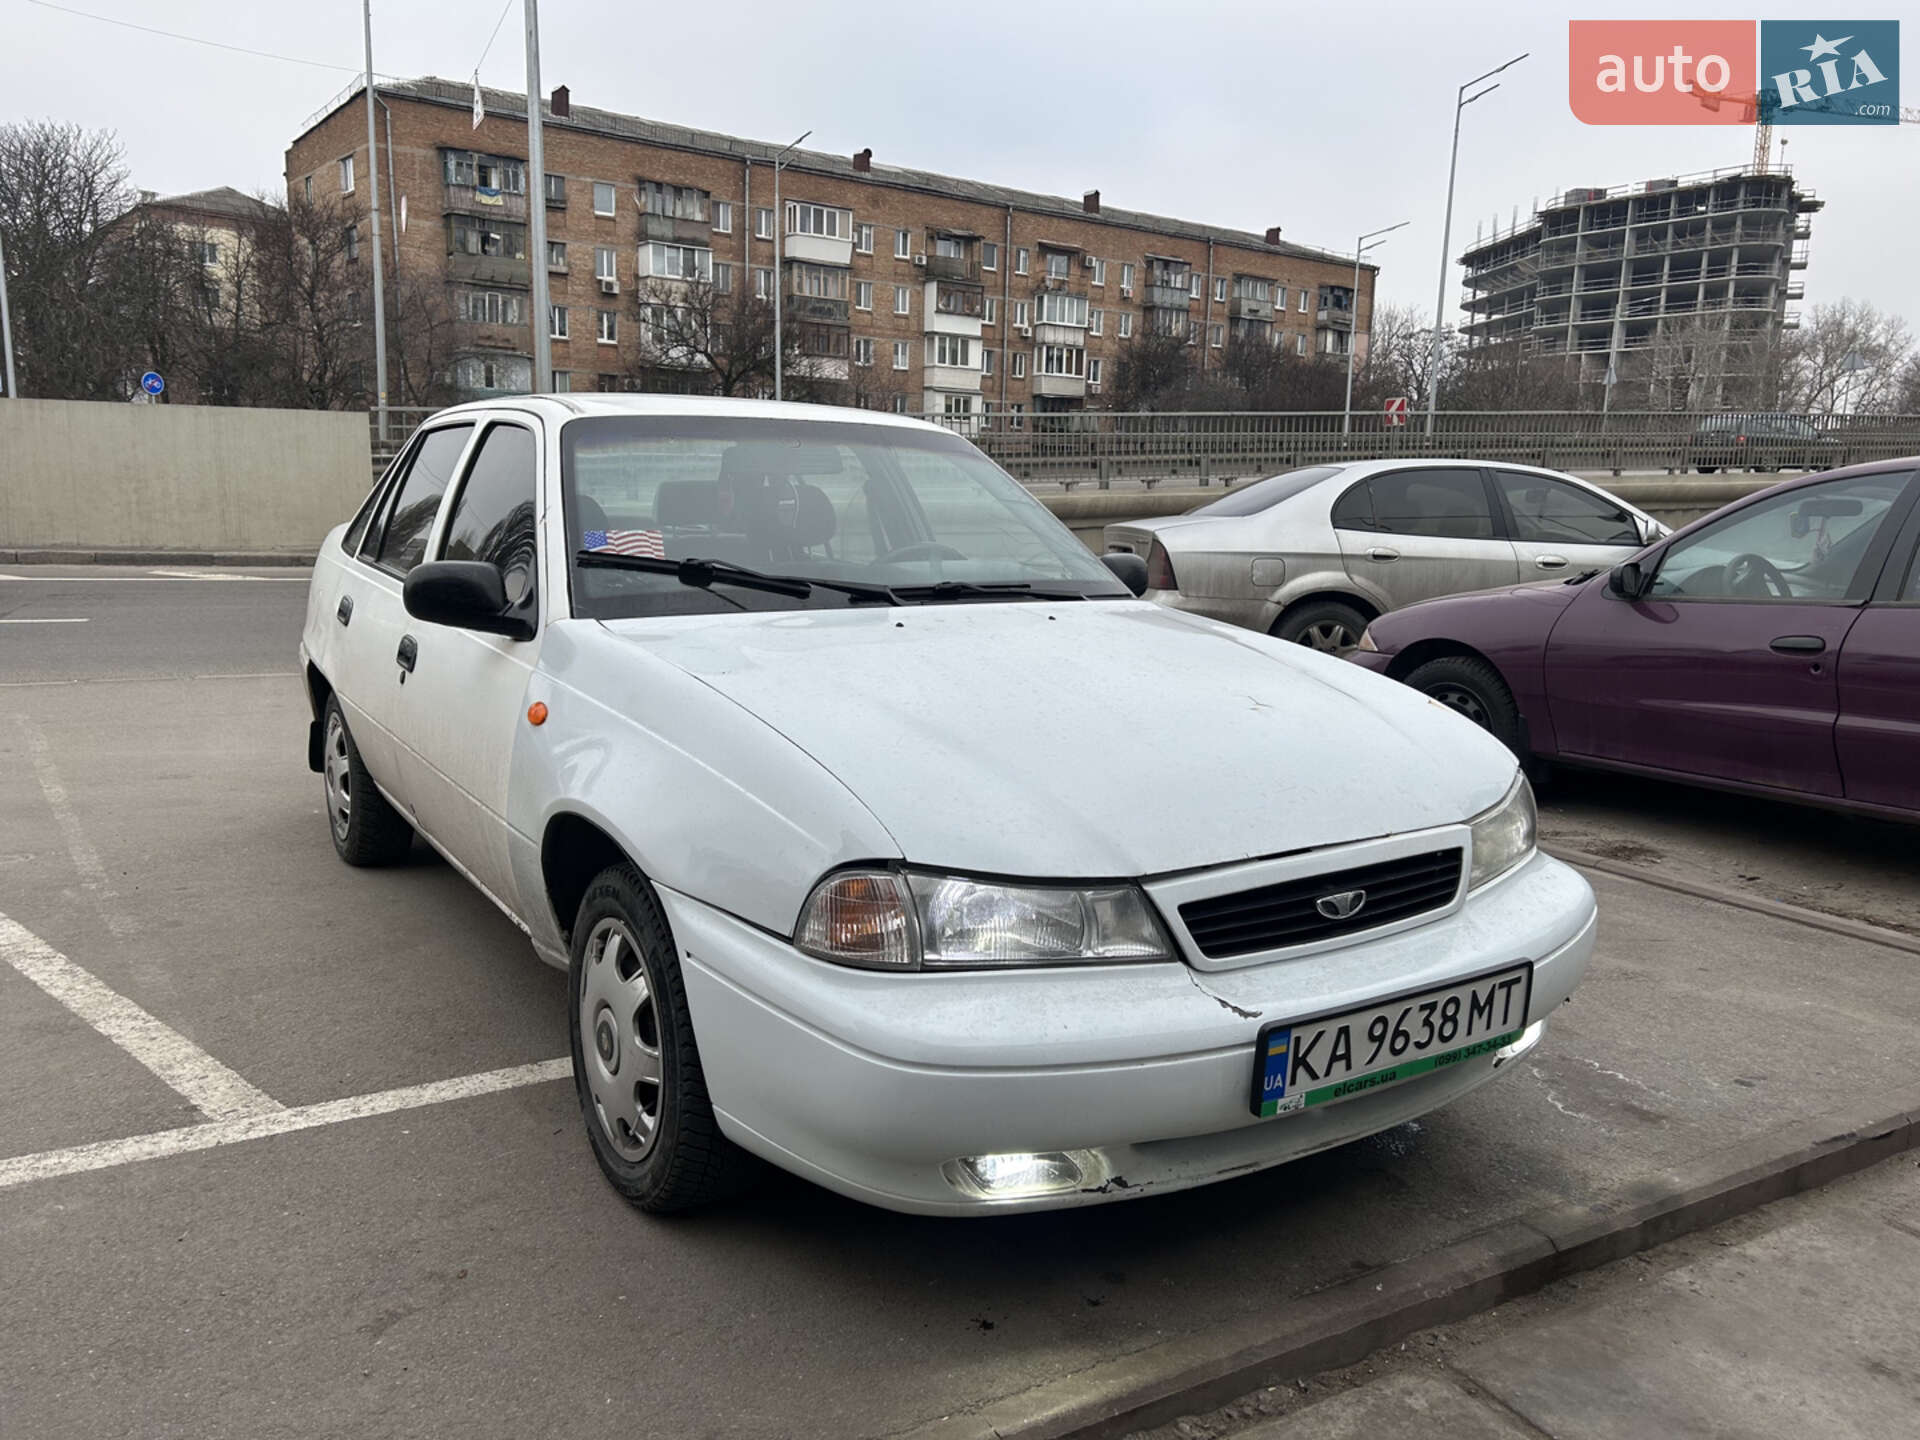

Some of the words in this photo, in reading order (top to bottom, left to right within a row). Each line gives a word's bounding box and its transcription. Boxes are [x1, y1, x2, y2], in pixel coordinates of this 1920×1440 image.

[1289, 1025, 1352, 1086] KA
[1365, 996, 1461, 1066] 9638
[1466, 976, 1522, 1036] MT
[1264, 1073, 1284, 1091] UA
[1333, 1071, 1397, 1098] elcars.ua
